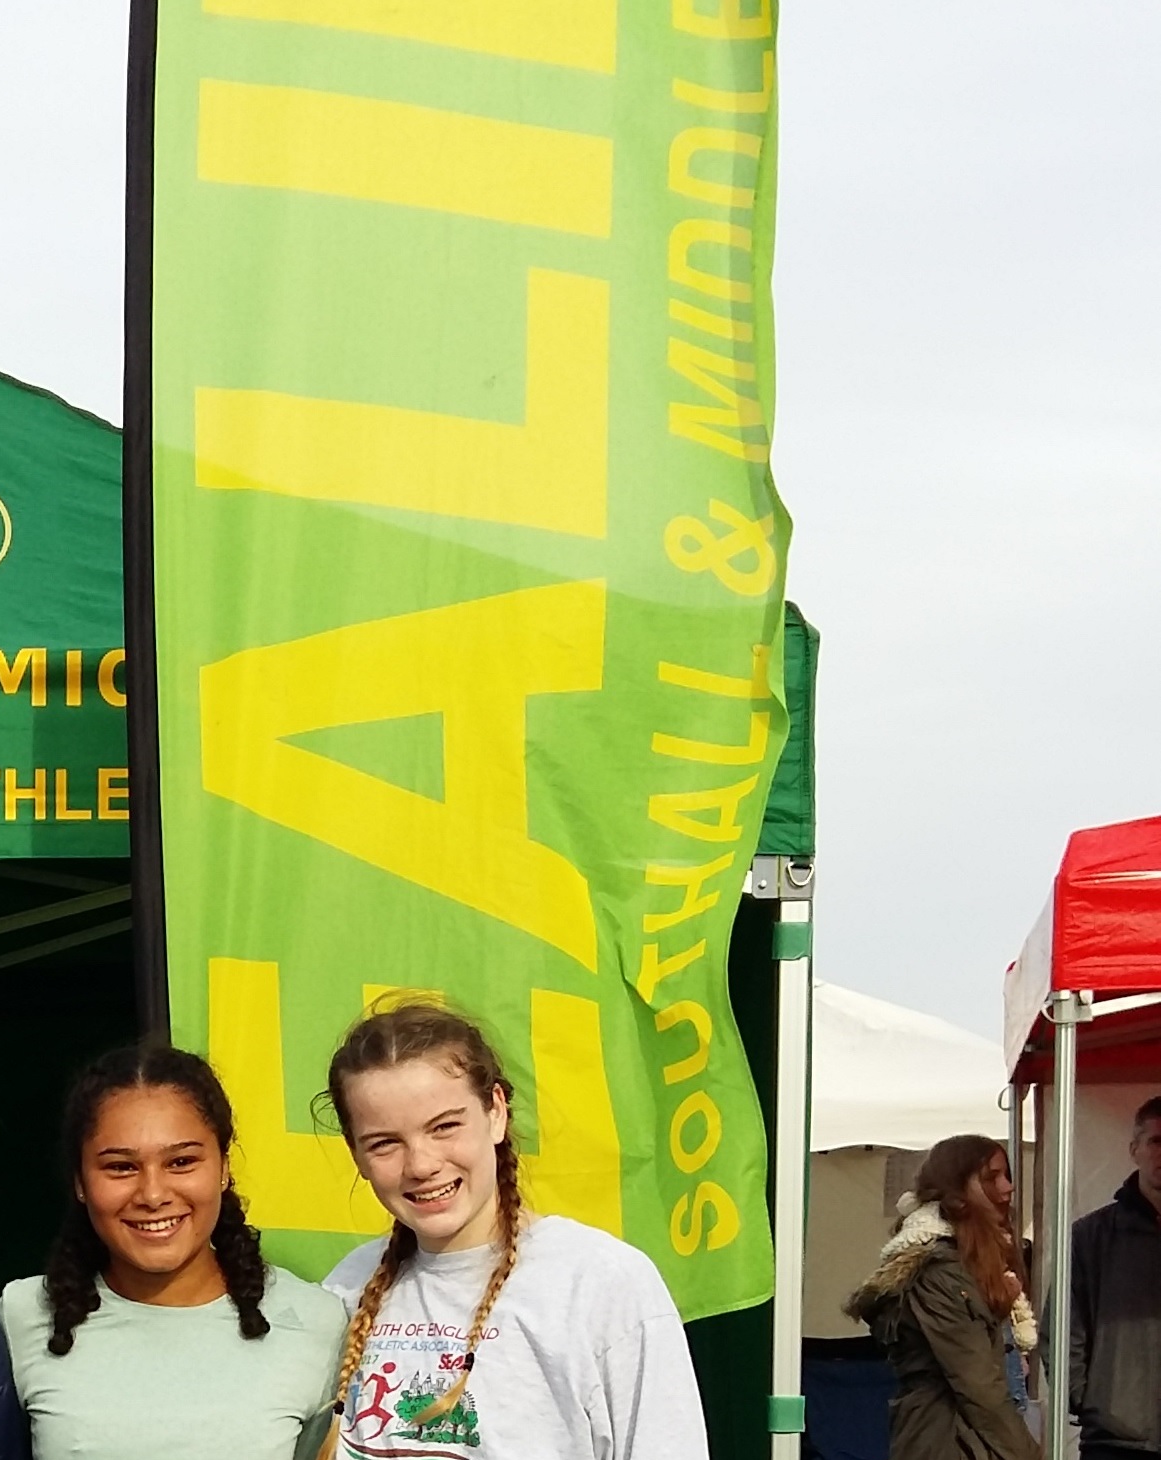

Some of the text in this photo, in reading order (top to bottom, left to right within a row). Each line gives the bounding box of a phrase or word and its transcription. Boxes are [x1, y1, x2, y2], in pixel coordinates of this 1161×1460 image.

[663, 497, 776, 597] &
[195, 0, 623, 1237] EALI
[635, 643, 770, 1257] SOUTHALL
[360, 1354, 380, 1365] 017
[366, 1340, 480, 1353] THLETIC ASSOCIATIO
[367, 1322, 500, 1341] OUTH OF ENGLND
